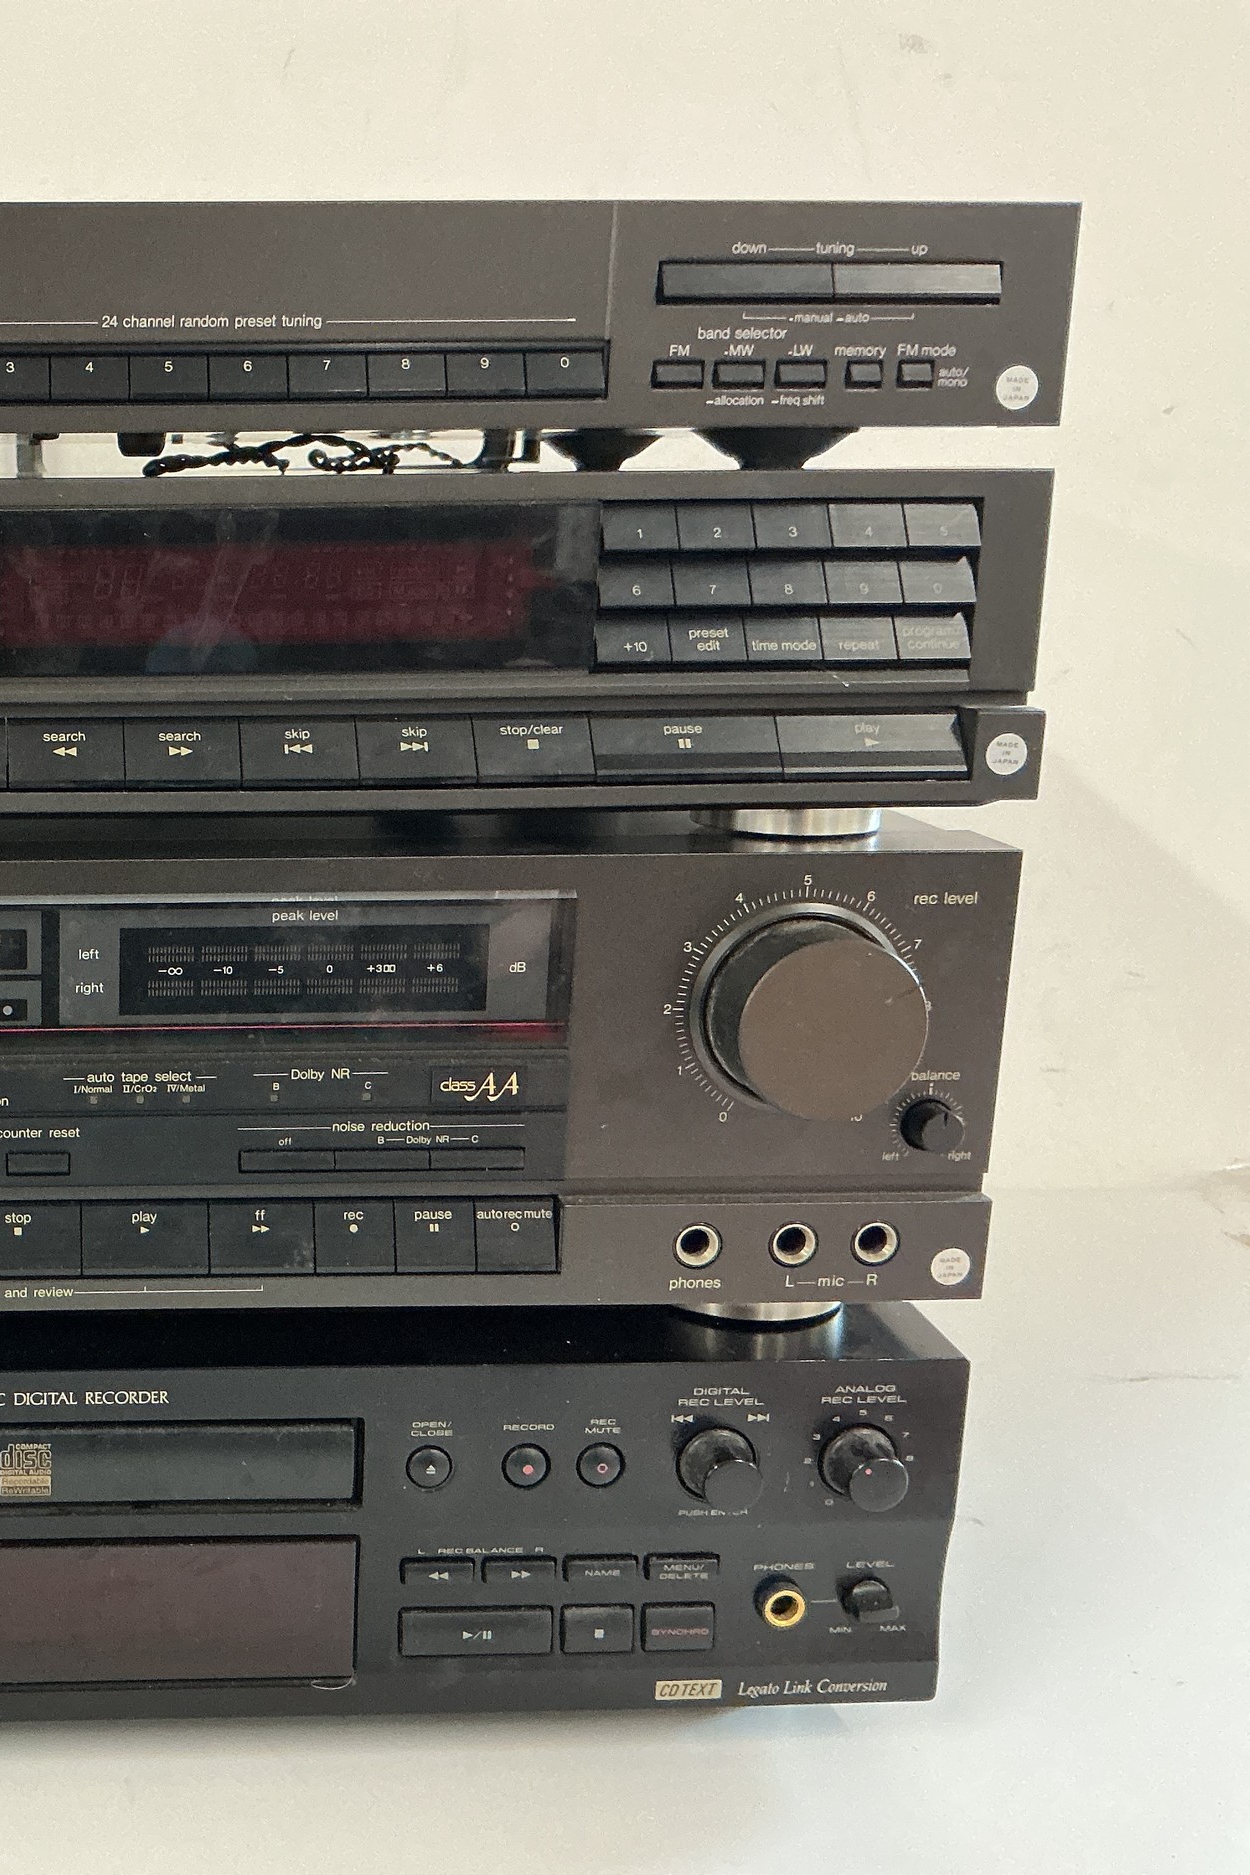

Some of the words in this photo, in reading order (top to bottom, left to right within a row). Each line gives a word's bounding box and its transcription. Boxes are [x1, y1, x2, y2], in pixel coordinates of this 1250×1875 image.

[731, 241, 767, 255] down
[815, 240, 856, 258] tuning
[910, 244, 929, 257] up
[101, 315, 119, 328] 24
[122, 314, 175, 328] channel
[180, 314, 229, 328] random
[234, 314, 277, 330] preset
[281, 314, 323, 330] tuning
[697, 326, 731, 340] band
[734, 326, 788, 340] selector
[669, 344, 691, 357] FM
[728, 344, 755, 357] MW
[792, 344, 814, 357] LW
[834, 345, 887, 359] memory
[897, 343, 919, 357] FM
[921, 345, 957, 357] mode
[713, 394, 765, 406] allocation
[779, 394, 801, 407] freq
[801, 394, 825, 406] shift
[688, 627, 730, 642] preset
[623, 641, 648, 653] +10
[696, 639, 721, 652] edit
[751, 639, 781, 652] time
[781, 639, 817, 651] mode
[284, 728, 311, 741] skip
[401, 726, 428, 739] skip
[499, 724, 564, 737] stop/clear
[663, 723, 703, 736] pause
[854, 722, 880, 736] play
[42, 731, 86, 742] search
[158, 731, 201, 742] search
[913, 894, 938, 905] rec
[943, 891, 978, 905] level
[271, 909, 305, 924] peak
[309, 909, 339, 921] level
[78, 948, 100, 960] left
[75, 981, 104, 996] right
[86, 1072, 115, 1083] auto
[120, 1071, 149, 1086] tape
[154, 1070, 192, 1082] select
[291, 1068, 325, 1082] Dolby
[331, 1067, 351, 1080] NR
[911, 1069, 961, 1081] balance
[332, 1120, 366, 1132] noise
[371, 1119, 431, 1132] reduction
[49, 1127, 81, 1138] reset
[4, 1212, 32, 1225] stop
[131, 1210, 157, 1225] play
[254, 1209, 266, 1221] ff
[343, 1209, 364, 1221] rec
[414, 1210, 453, 1223] pause
[668, 1276, 721, 1291] phones
[785, 1274, 795, 1288] L
[817, 1274, 845, 1287] mic
[866, 1273, 878, 1286] R
[4, 1286, 28, 1298] and
[33, 1286, 74, 1298] review
[693, 1387, 750, 1396] DIGITAL
[834, 1384, 896, 1394] ANALOG
[13, 1391, 78, 1406] DIGITAL
[85, 1390, 170, 1405] RECORDER
[678, 1398, 713, 1407] REC
[716, 1397, 765, 1407] LEVEL
[821, 1395, 853, 1405] REC
[856, 1395, 907, 1404] LEVEL
[410, 1429, 453, 1437] CLOSE
[503, 1423, 555, 1431] RECORD
[753, 1562, 815, 1571] PHONES
[846, 1560, 895, 1569] LEVEL
[584, 1569, 621, 1577] NAME
[737, 1681, 780, 1699] Legato
[783, 1679, 813, 1695] Link
[816, 1678, 888, 1694] Conversion
